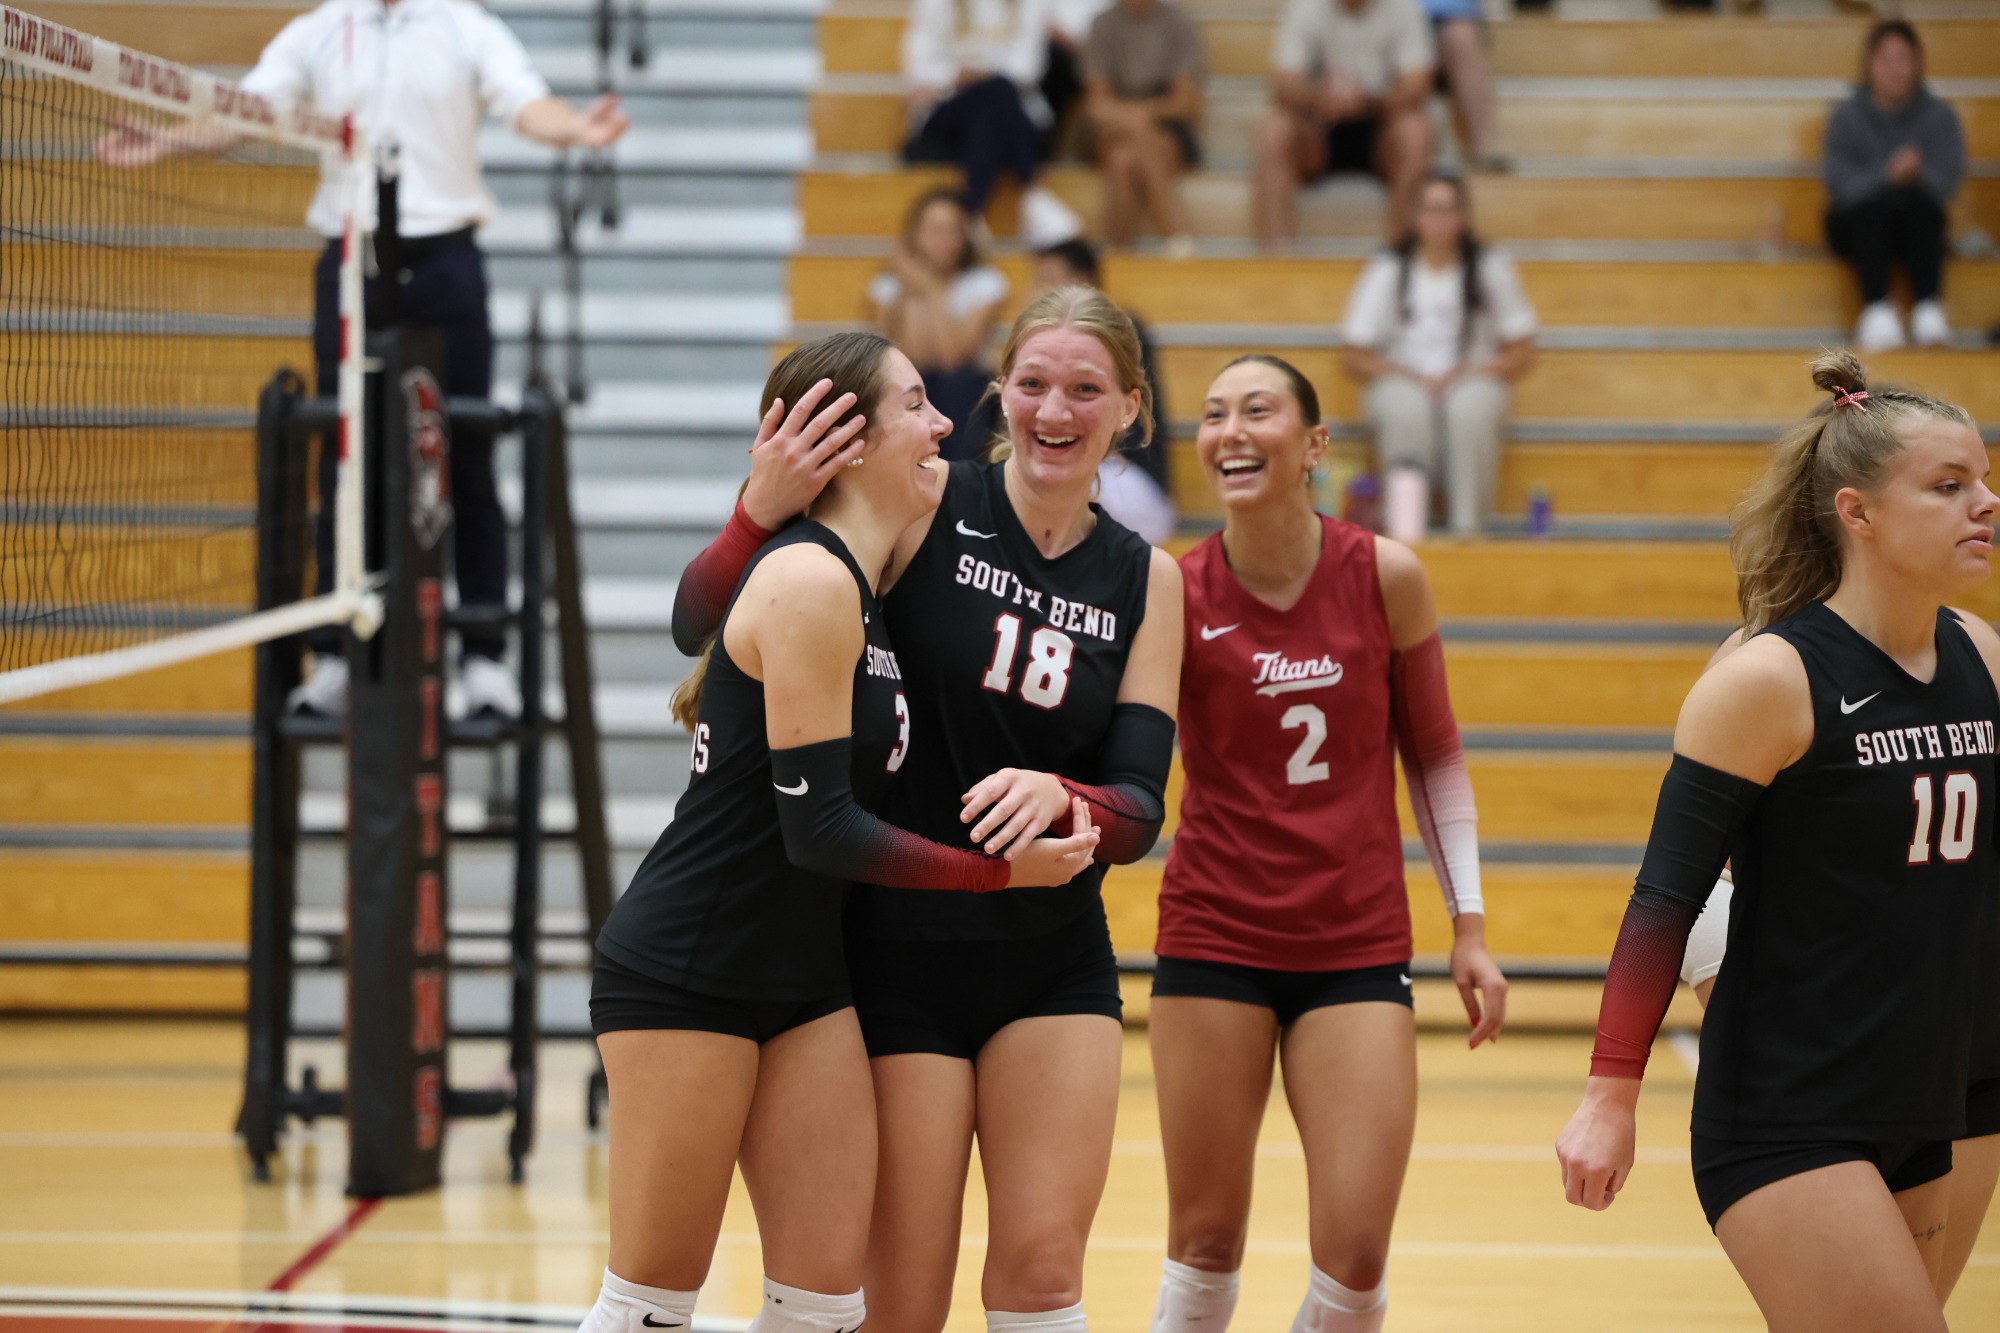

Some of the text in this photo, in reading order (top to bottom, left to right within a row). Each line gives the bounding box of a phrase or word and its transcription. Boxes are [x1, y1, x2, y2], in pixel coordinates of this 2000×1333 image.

[955, 554, 1116, 641] SOUTH BEND
[980, 611, 1077, 711] 18
[1252, 651, 1343, 697] Titans
[691, 721, 711, 774] S
[885, 691, 910, 774] 3
[1281, 704, 1330, 785] 2
[1855, 720, 1995, 766] SOUTH BEND
[1906, 770, 1980, 867] 10
